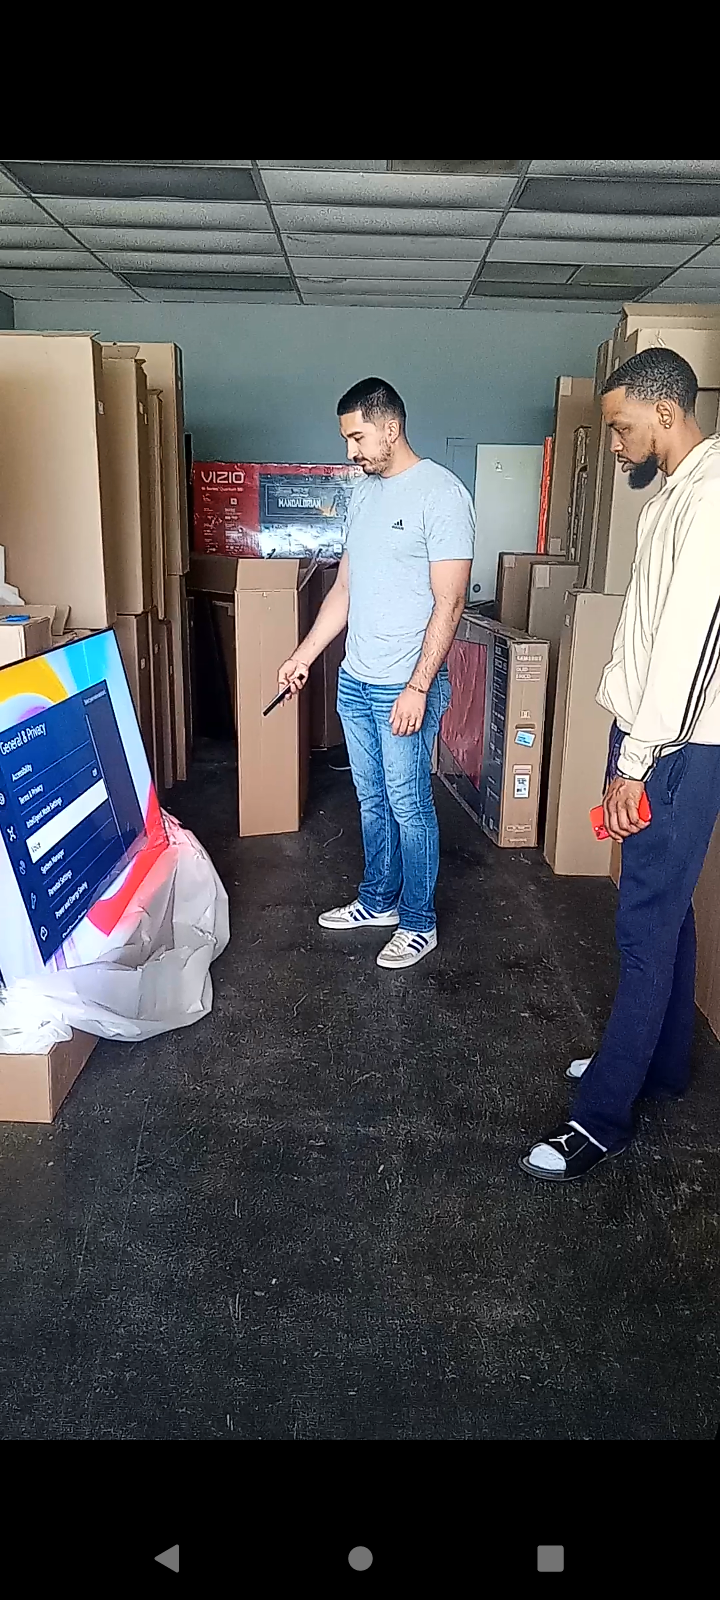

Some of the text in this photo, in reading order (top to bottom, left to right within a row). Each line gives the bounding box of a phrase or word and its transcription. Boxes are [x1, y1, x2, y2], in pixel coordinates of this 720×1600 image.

[201, 471, 244, 484] VIZIO
[278, 498, 320, 508] MANDALORIAN
[0, 723, 47, 755] General & Privacy
[12, 764, 32, 781] Accessibility
[31, 784, 44, 798] Privacy
